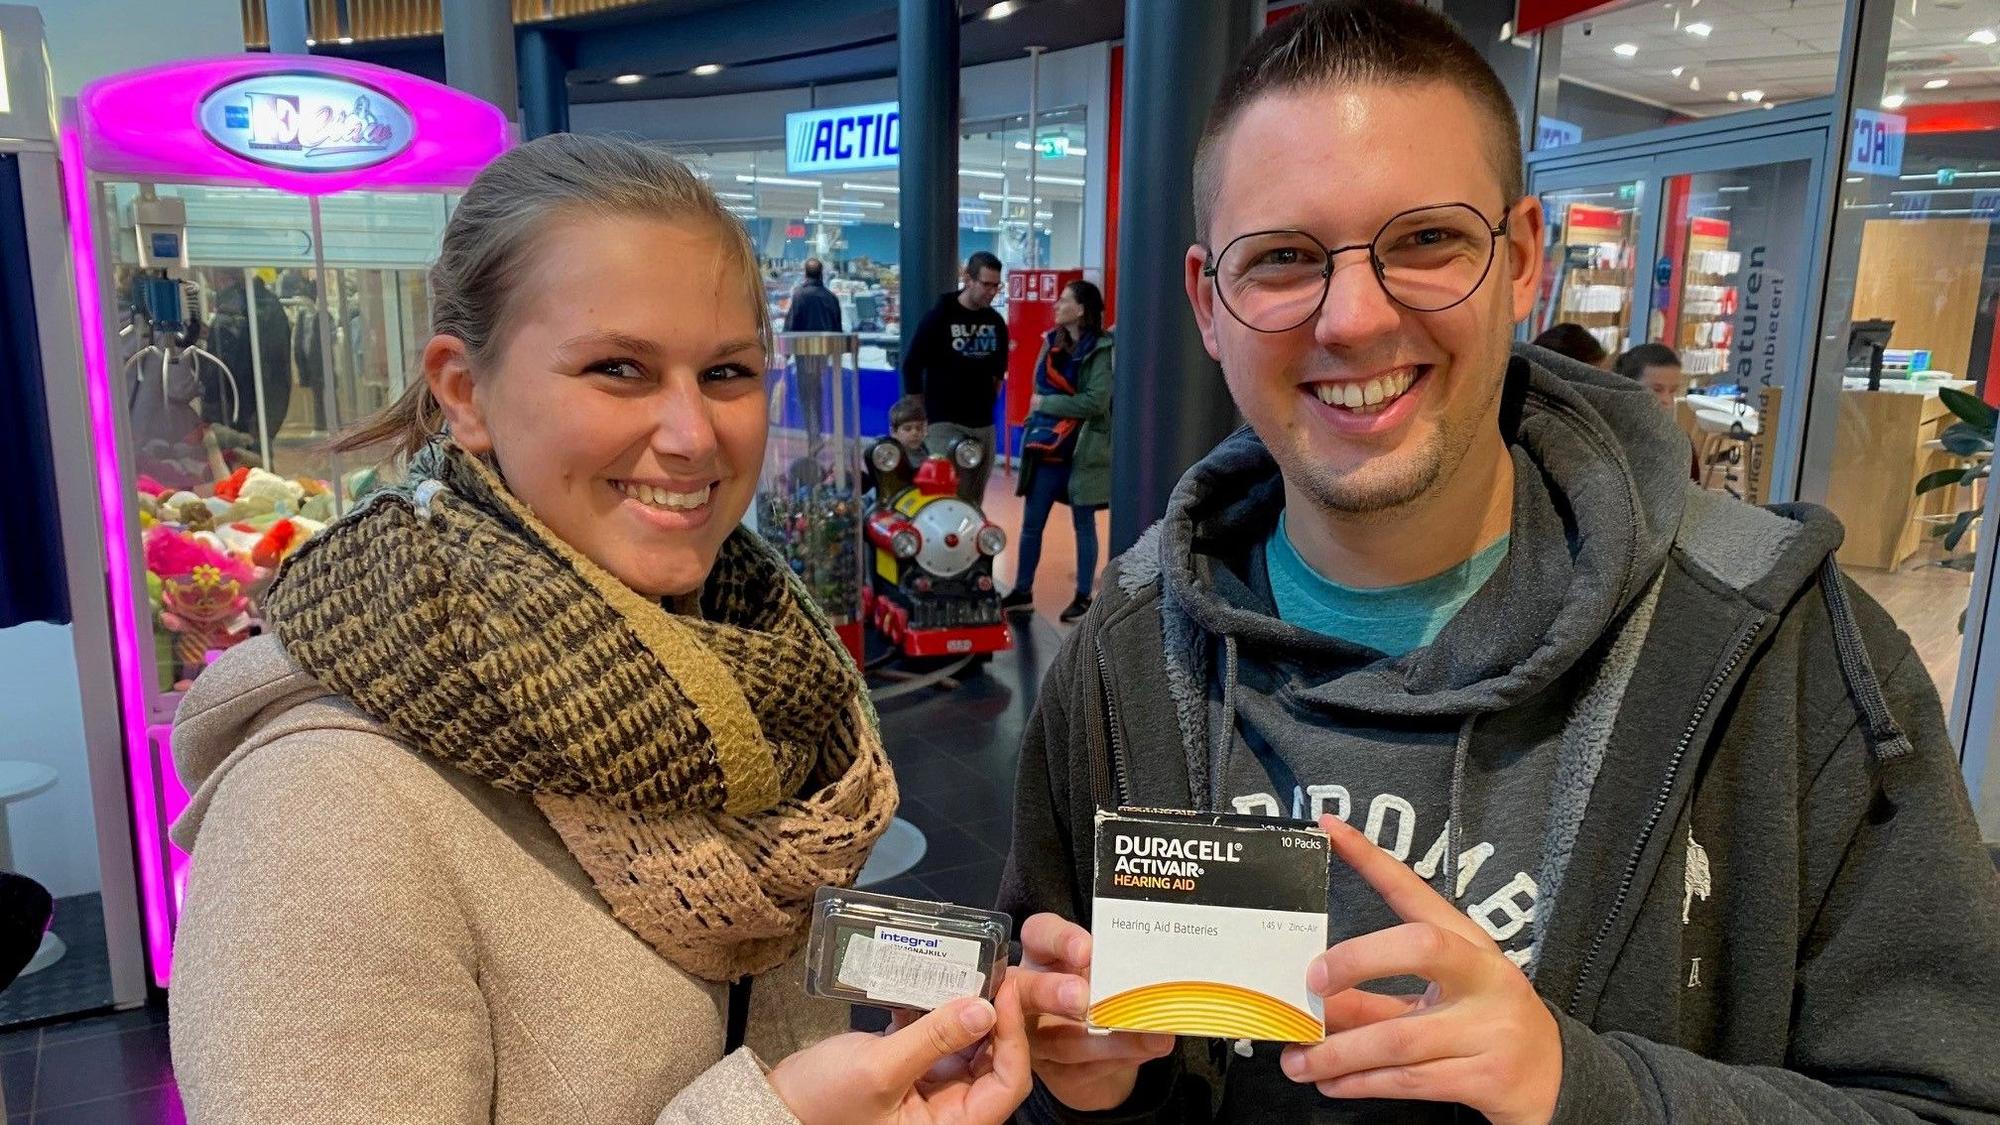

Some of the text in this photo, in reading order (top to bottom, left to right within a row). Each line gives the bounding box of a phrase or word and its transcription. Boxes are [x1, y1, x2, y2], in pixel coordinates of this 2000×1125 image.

[1281, 836, 1321, 850] 10 Packs
[1114, 873, 1195, 891] HEARING AID
[1111, 917, 1219, 936] Hearing Aid Batteries
[1277, 922, 1283, 931] V
[1288, 922, 1318, 933] Zinc-Air
[880, 930, 938, 948] integral
